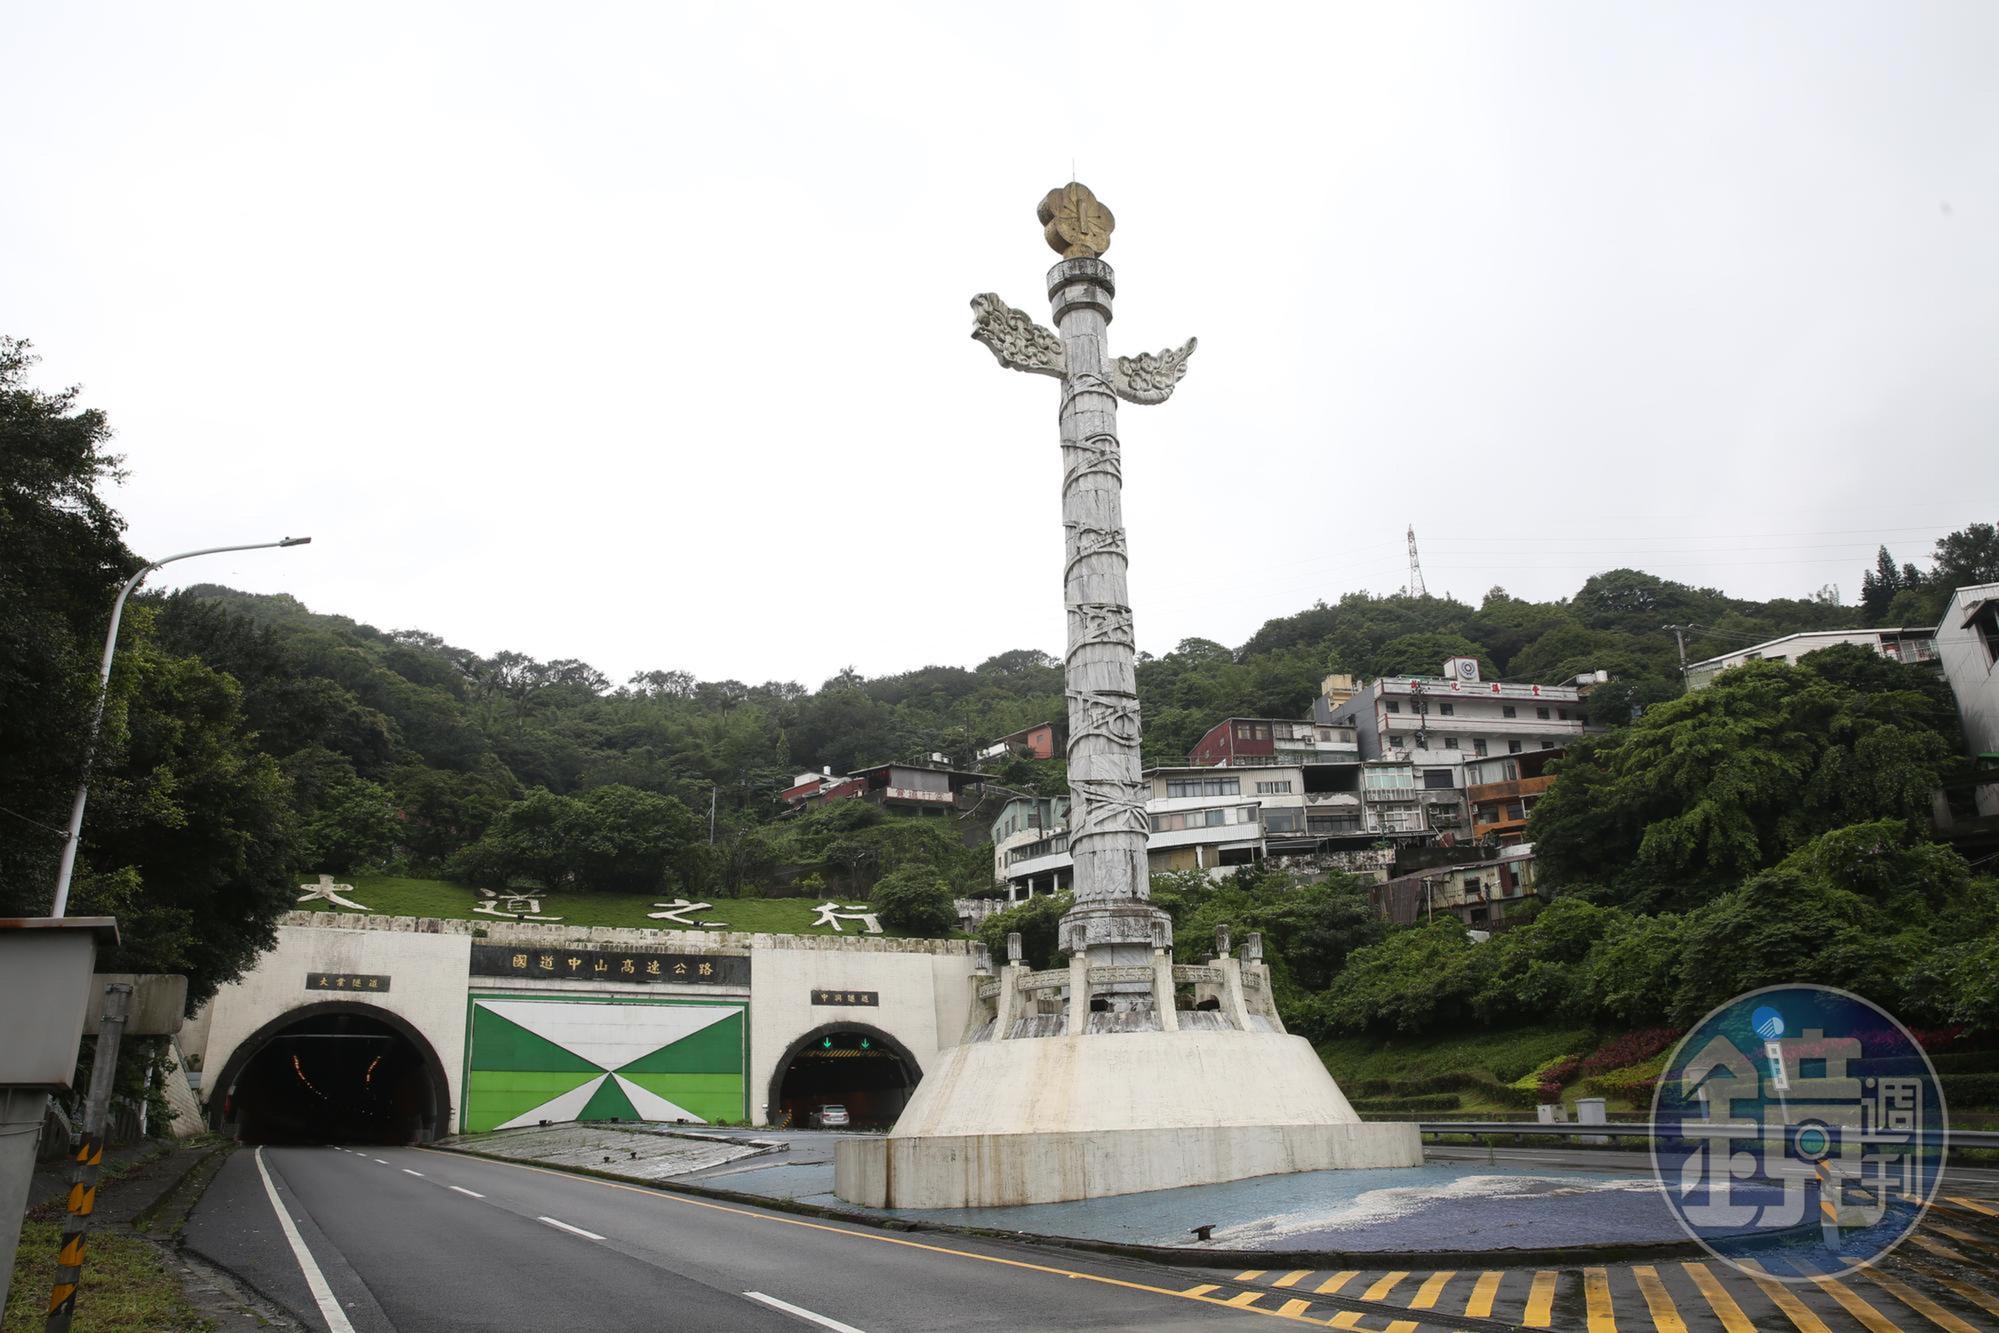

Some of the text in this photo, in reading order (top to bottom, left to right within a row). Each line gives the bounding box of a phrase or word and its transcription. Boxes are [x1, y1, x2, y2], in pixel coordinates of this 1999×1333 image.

[297, 873, 884, 934] 大道之行
[512, 954, 713, 976] 國道中山高速公路
